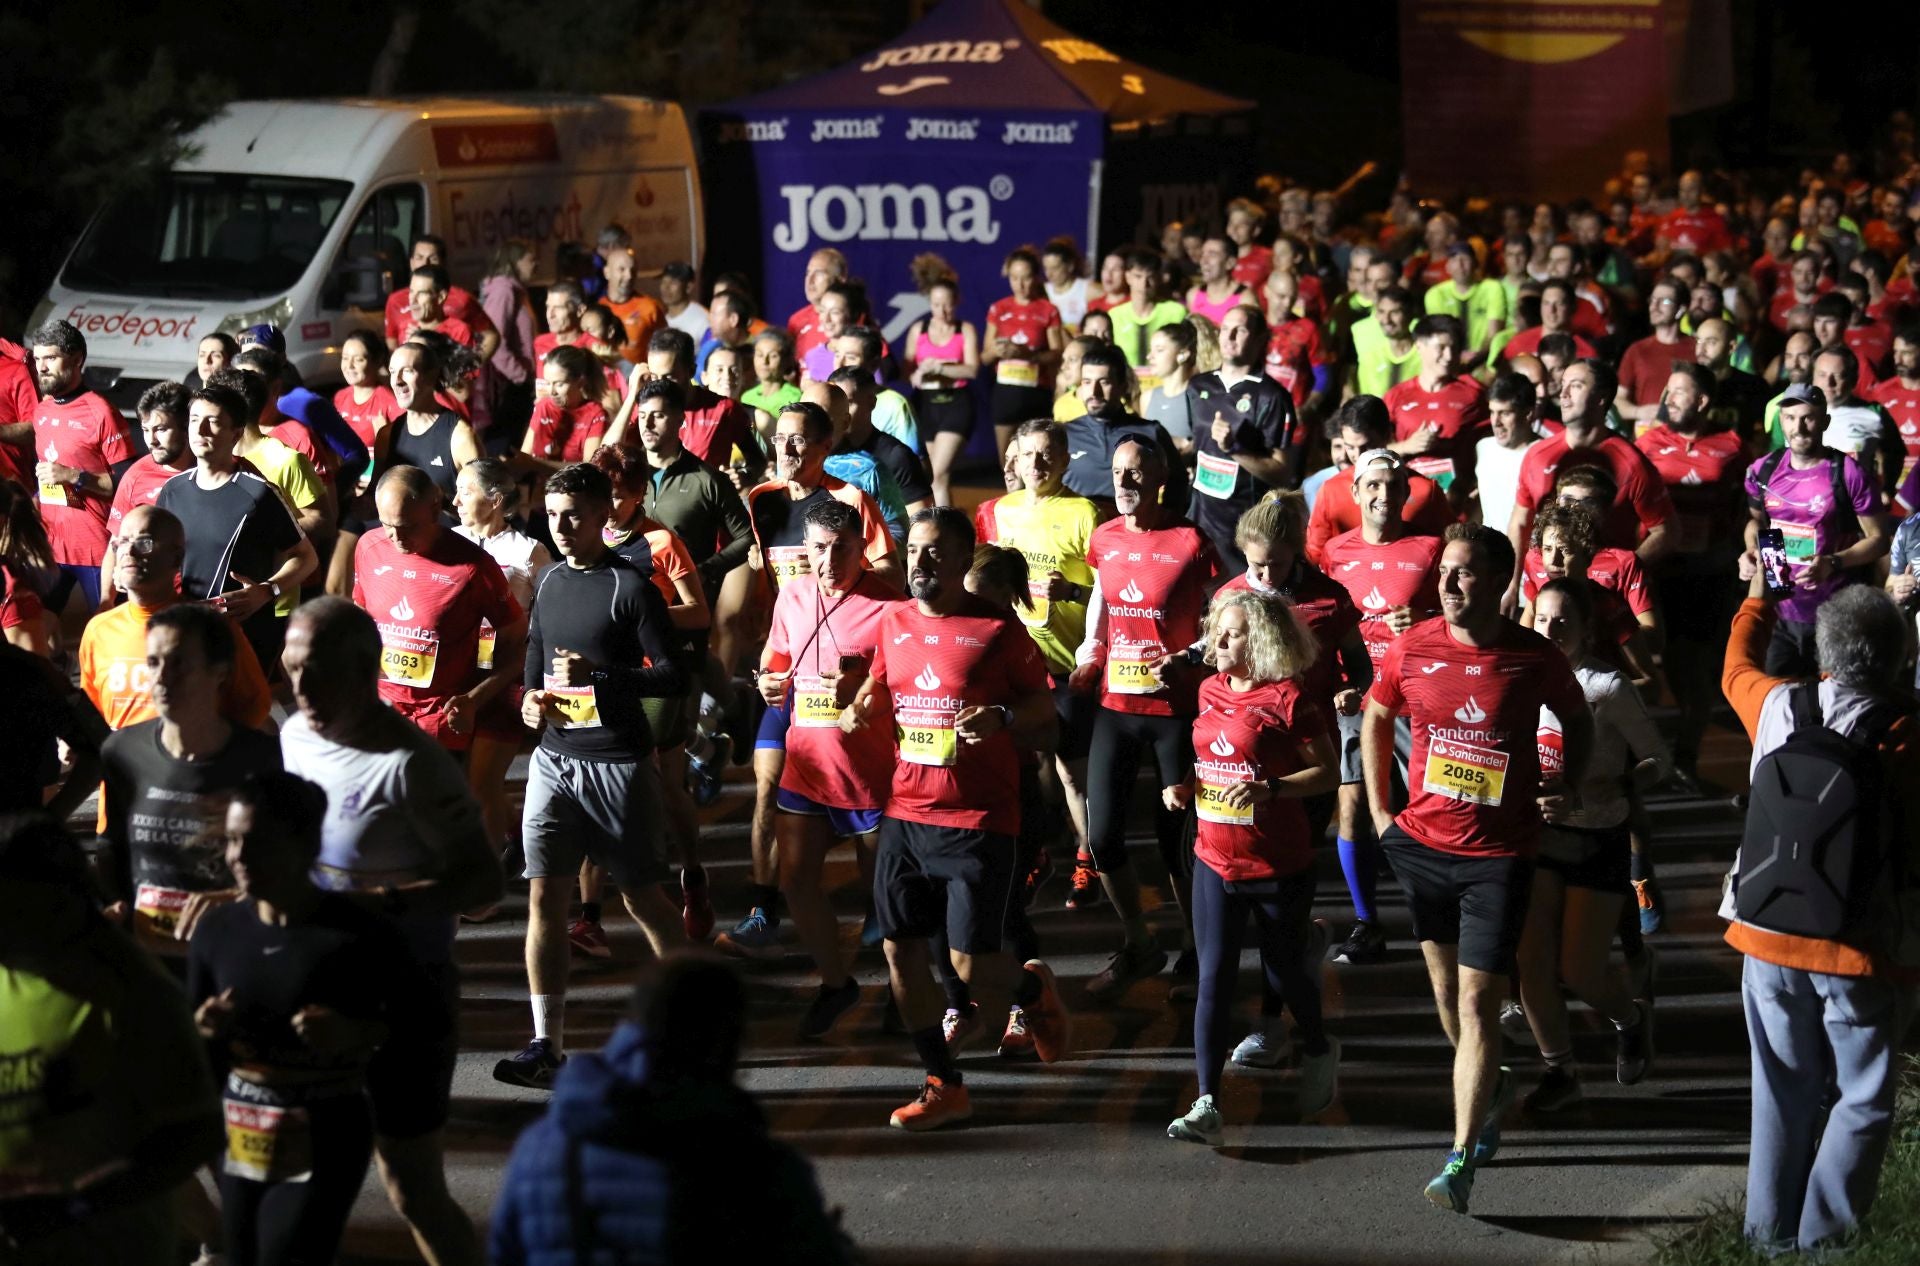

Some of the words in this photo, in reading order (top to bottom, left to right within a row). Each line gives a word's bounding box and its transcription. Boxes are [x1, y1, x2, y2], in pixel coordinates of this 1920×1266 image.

[450, 188, 582, 249] Evedeport
[66, 305, 196, 345] Evedeport
[1107, 602, 1166, 621] Santander
[388, 637, 435, 654] Santander
[384, 651, 418, 669] 2063
[1118, 665, 1149, 677] 2170
[895, 691, 966, 711] Santander
[905, 712, 954, 727] Santander
[909, 732, 934, 745] 482
[1427, 723, 1512, 743] Santander
[1447, 746, 1505, 768] Santander
[1442, 763, 1486, 785] 2085
[1448, 780, 1477, 792] SANTIAGO
